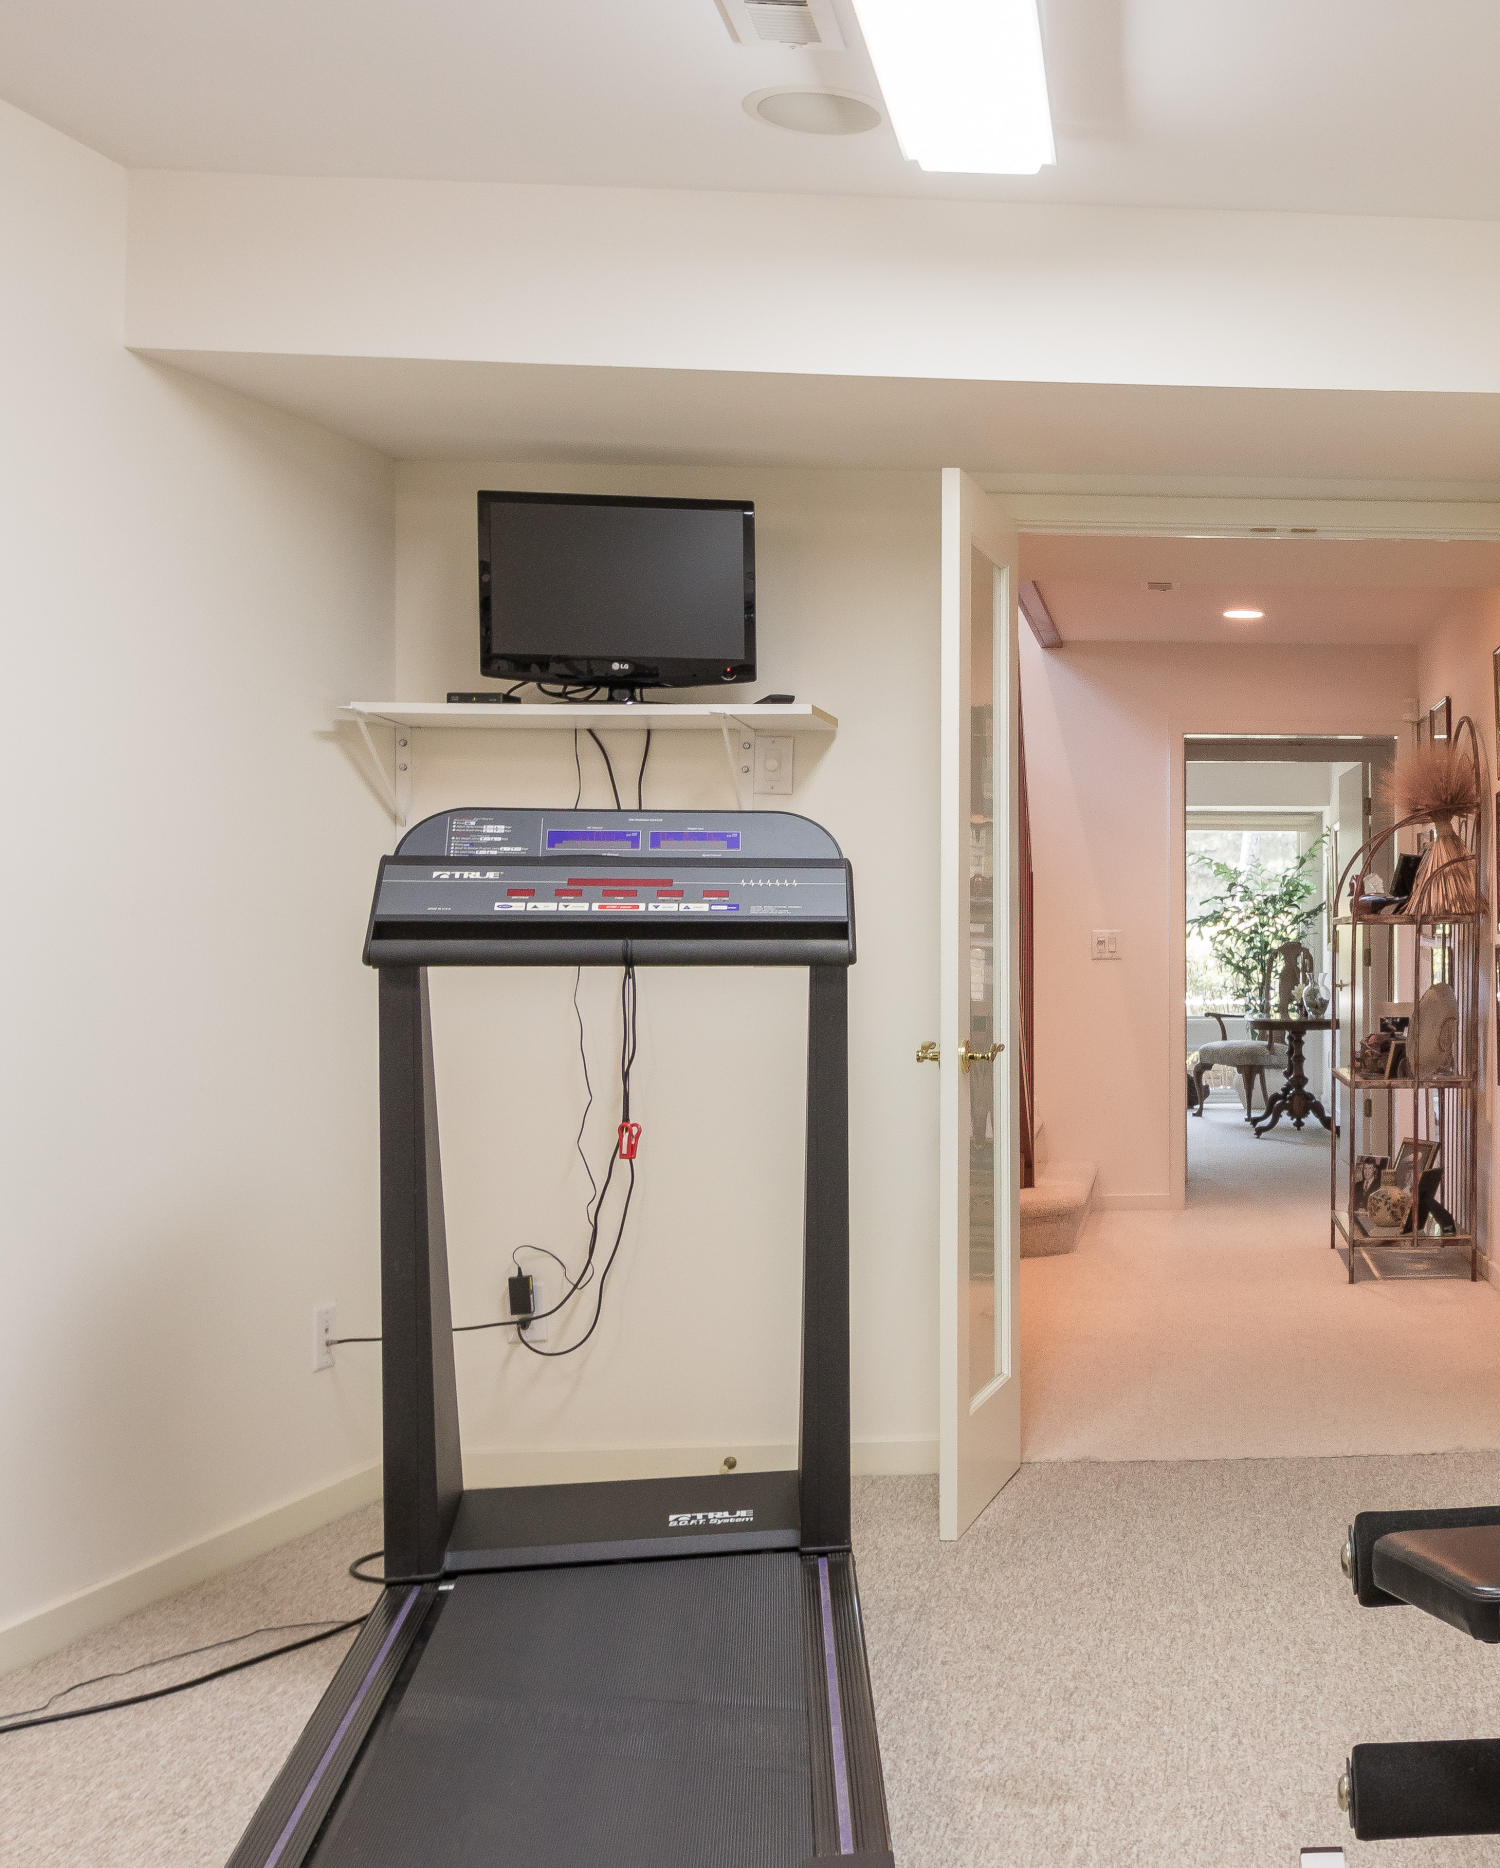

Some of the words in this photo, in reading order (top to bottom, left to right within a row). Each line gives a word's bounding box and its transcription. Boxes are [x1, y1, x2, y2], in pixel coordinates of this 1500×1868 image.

[450, 871, 501, 879] TRUE
[691, 1509, 754, 1520] TRUE
[708, 1517, 754, 1525] System
